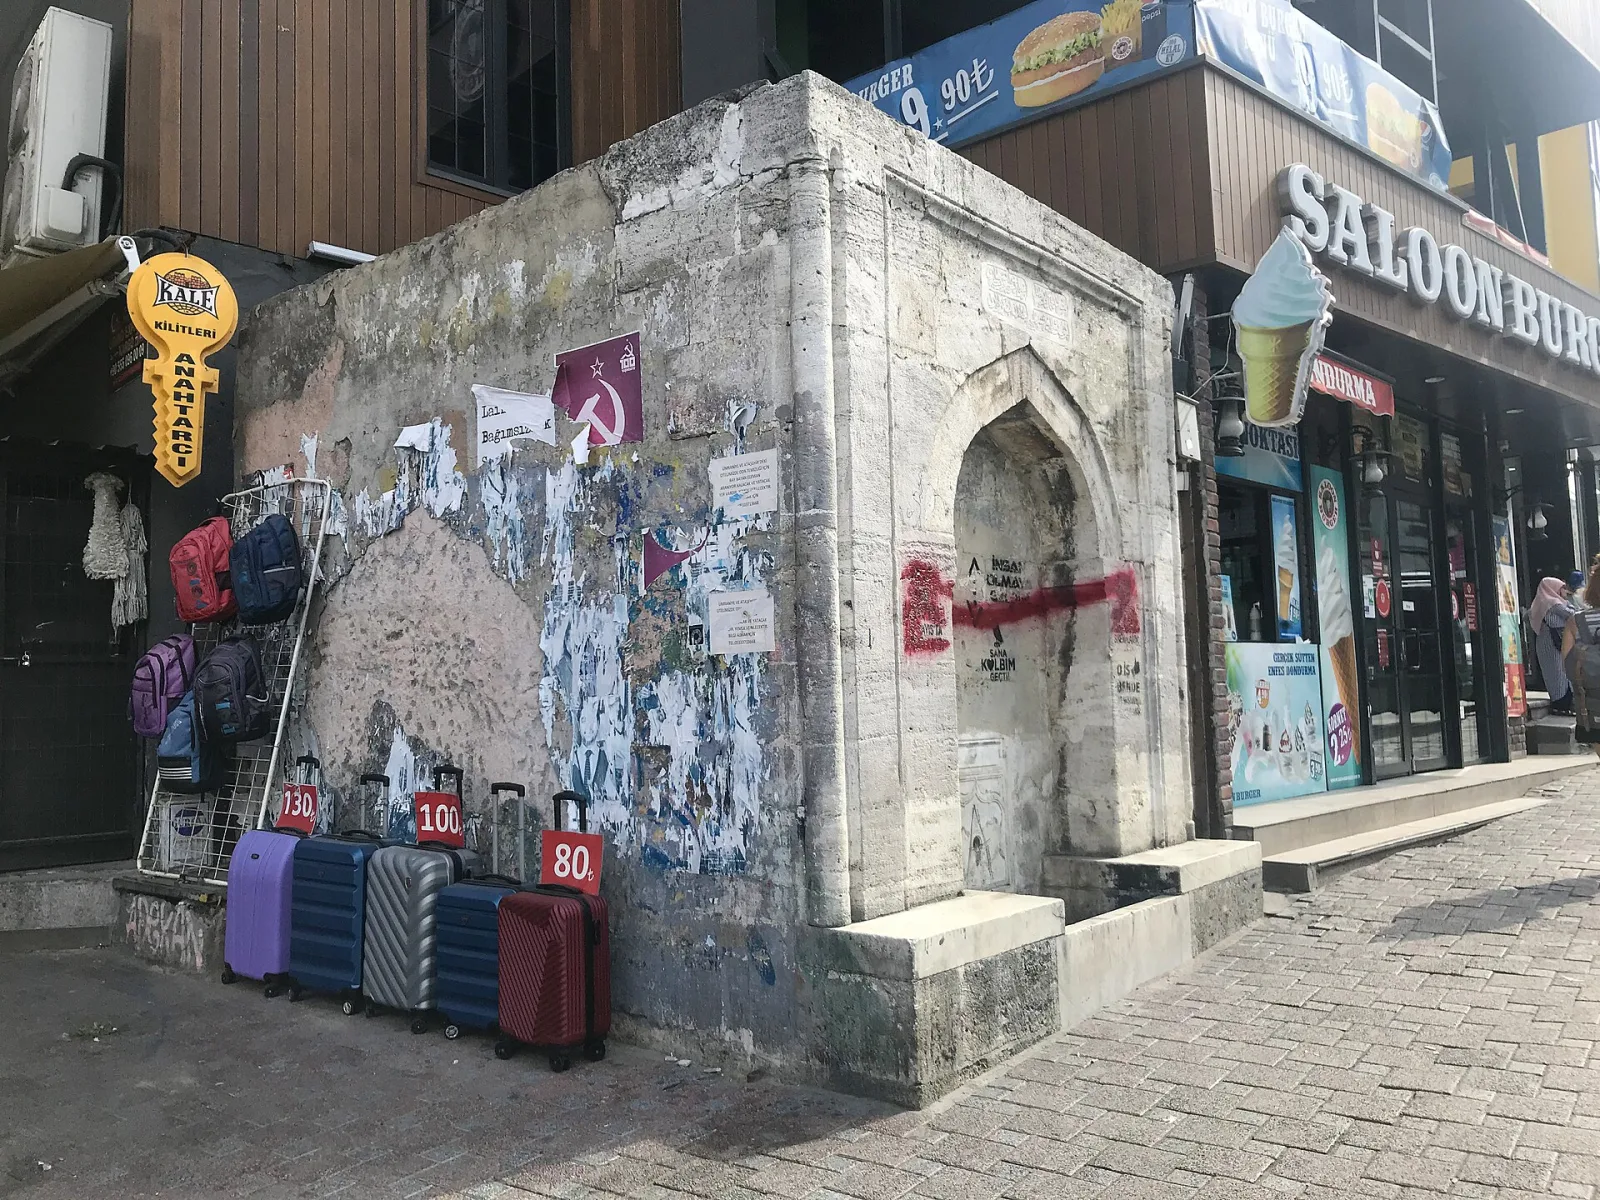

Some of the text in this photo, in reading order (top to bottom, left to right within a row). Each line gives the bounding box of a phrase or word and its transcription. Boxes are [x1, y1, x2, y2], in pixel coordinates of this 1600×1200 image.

[1141, 8, 1161, 23] pepsi
[901, 87, 931, 141] 9
[1280, 162, 1504, 333] SALOON
[160, 284, 214, 312] KALE
[154, 320, 216, 339] KİLİTLERİ
[620, 356, 636, 370] 100
[1310, 358, 1377, 407] NDURMA
[171, 352, 196, 467] ANAHTARCI
[989, 649, 1008, 658] SANA
[1236, 789, 1261, 801] BURGER
